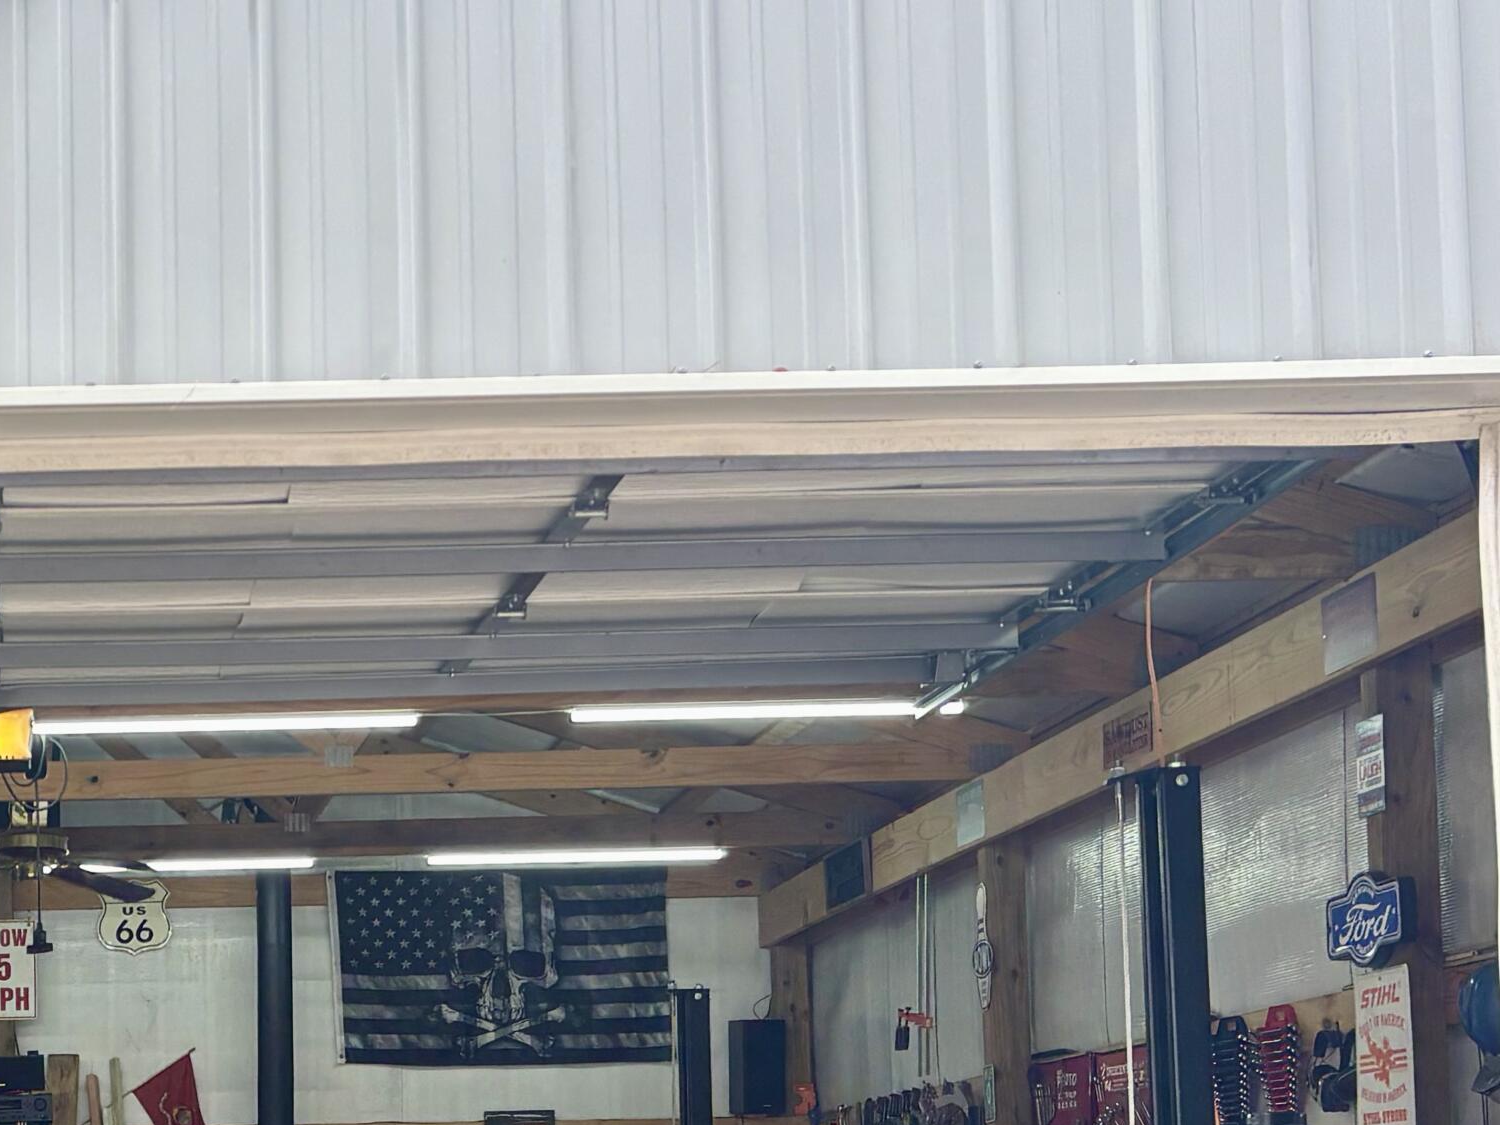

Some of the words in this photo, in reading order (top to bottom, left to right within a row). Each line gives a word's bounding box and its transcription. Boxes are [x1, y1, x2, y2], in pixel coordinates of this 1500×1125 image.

[122, 906, 146, 915] US
[1339, 901, 1392, 945] Ford
[116, 919, 154, 944] 66
[1361, 983, 1400, 1009] STIHL
